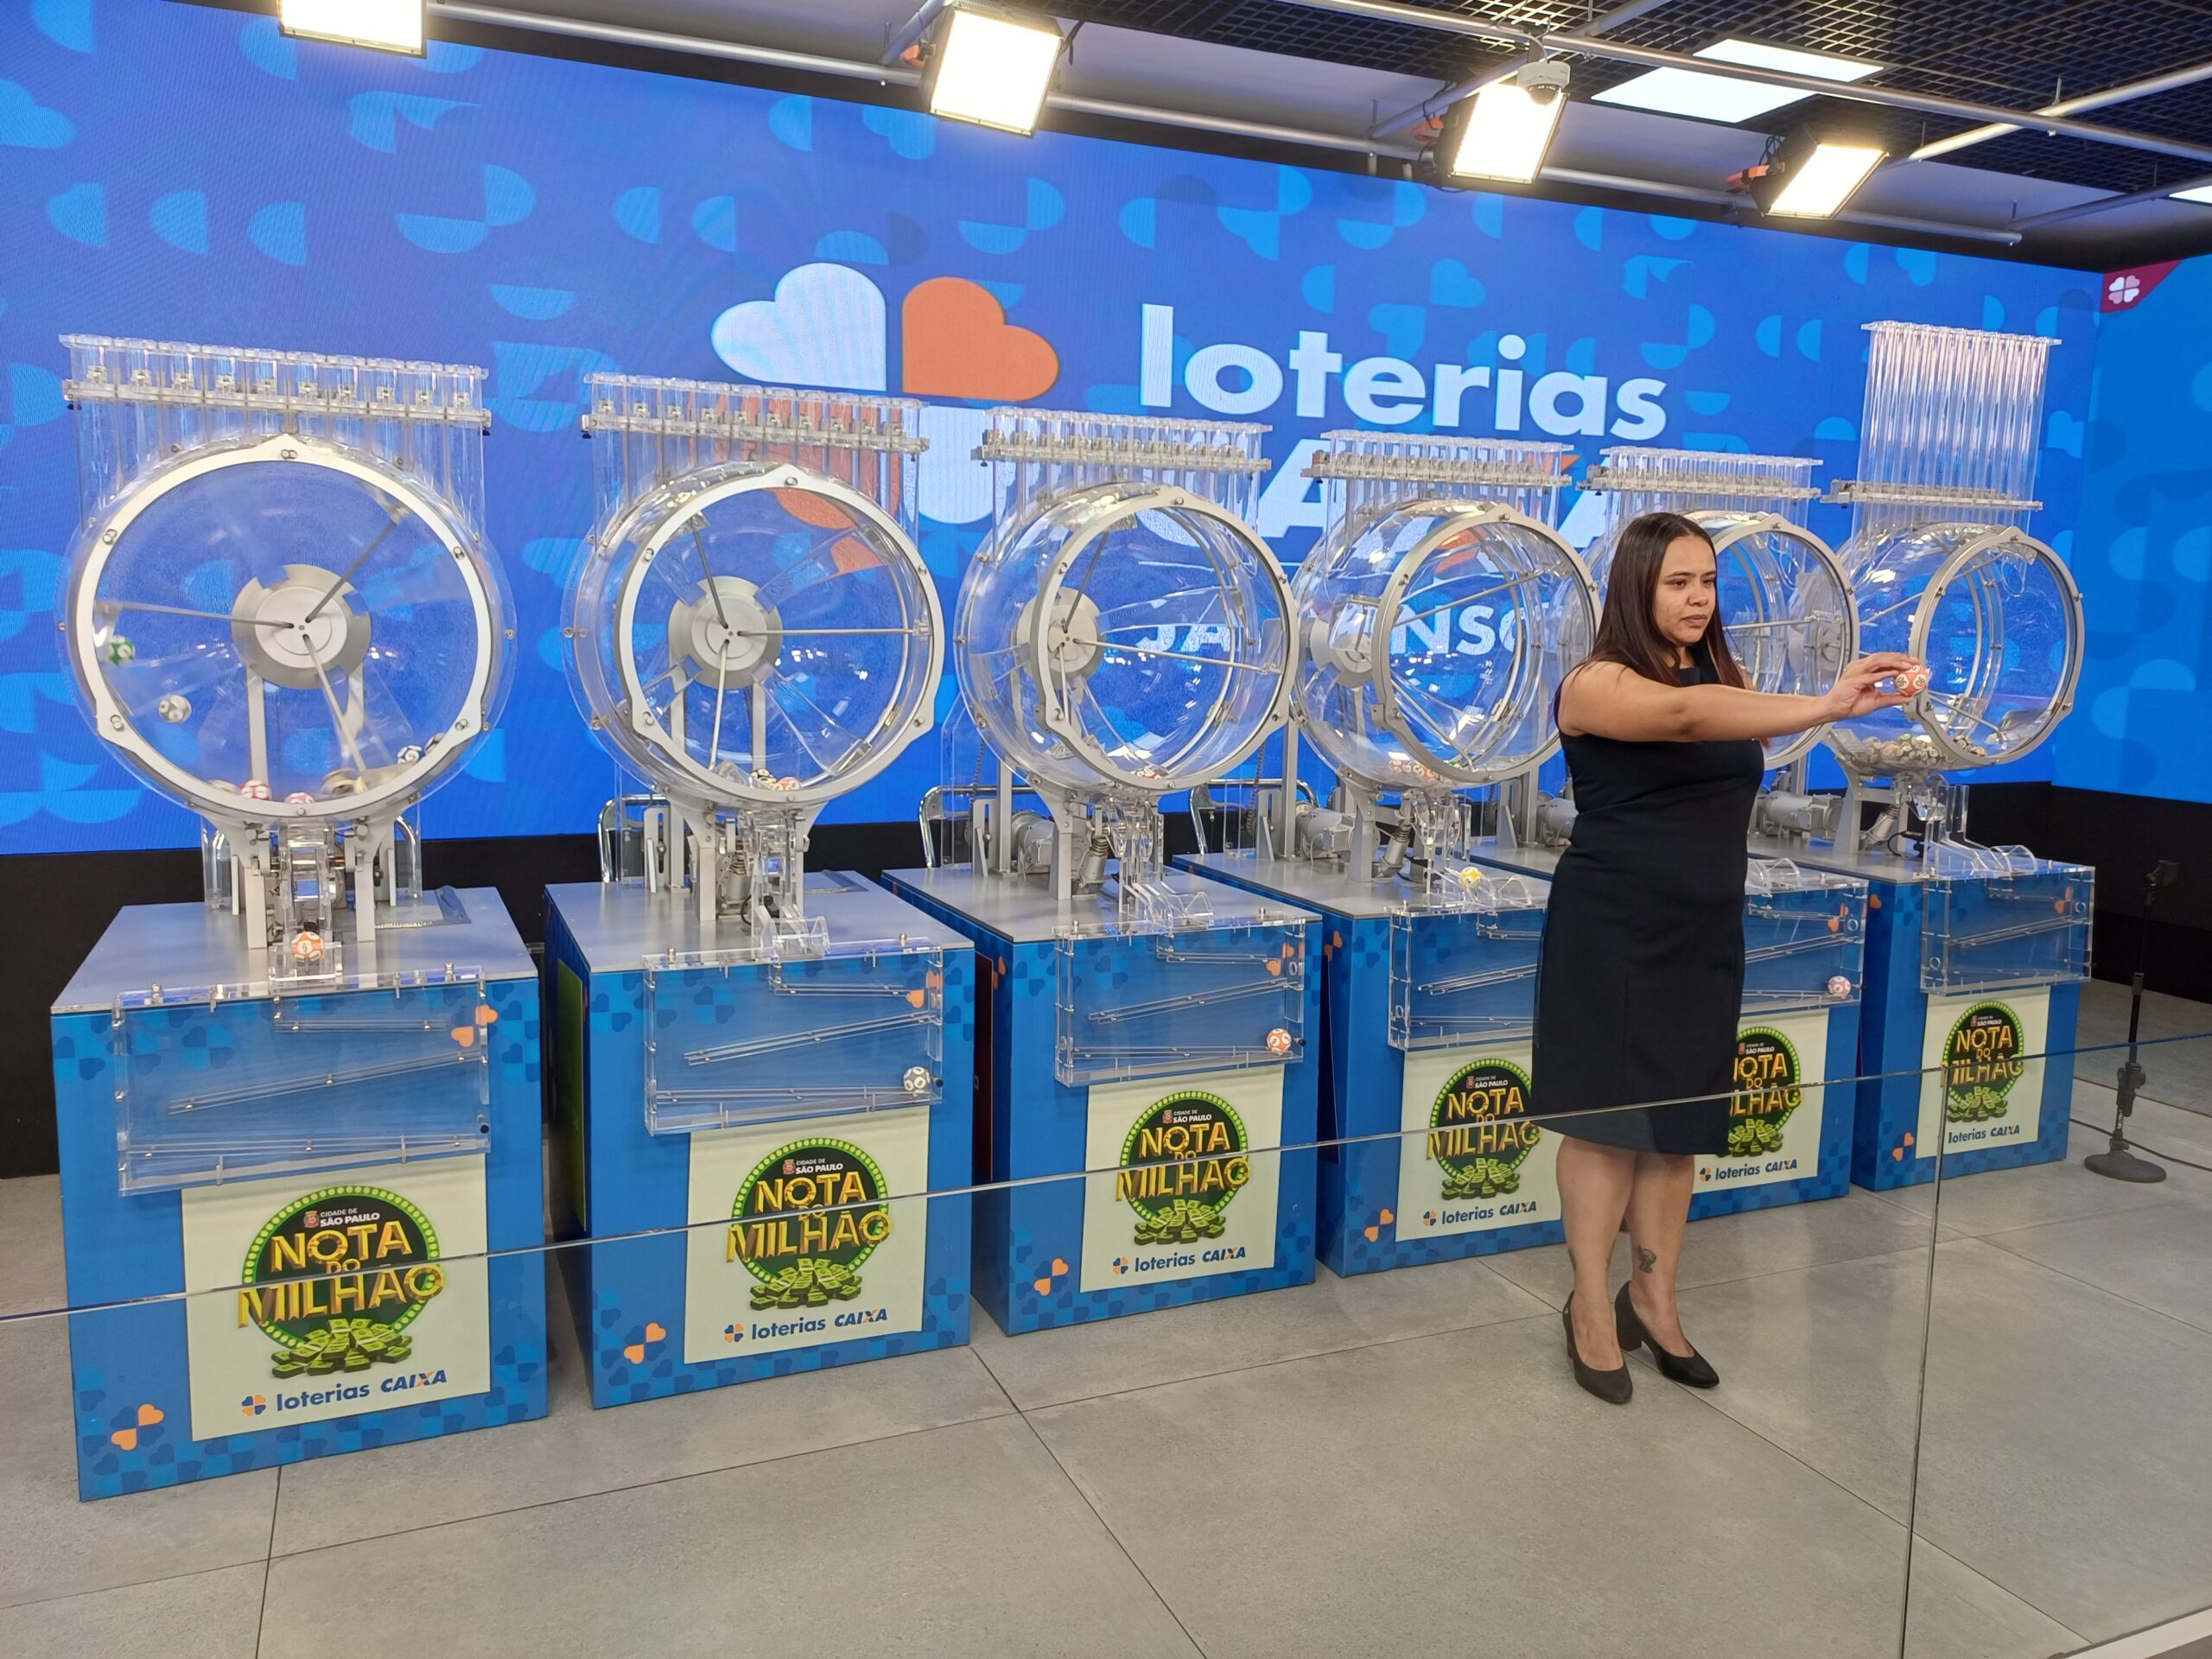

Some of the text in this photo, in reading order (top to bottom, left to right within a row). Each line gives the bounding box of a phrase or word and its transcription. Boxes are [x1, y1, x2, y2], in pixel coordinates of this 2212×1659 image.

[1140, 303, 1668, 441] loterias
[1956, 1026, 2012, 1054] NOTA
[1976, 1048, 1992, 1059] DO
[1745, 1077, 1763, 1090] DO
[1446, 1087, 1524, 1120] NOTA
[1189, 1114, 1212, 1122] PAULO
[1139, 1122, 1230, 1158] NOTA
[1948, 1125, 2020, 1144] loterias CAIXA
[795, 1163, 843, 1174] SÃO PAULO
[1715, 1160, 1797, 1180] loterias CAIXA
[754, 1171, 867, 1214] NOTA
[320, 1209, 346, 1217] CIDADE
[320, 1212, 380, 1227] SÃO PAULO
[1441, 1201, 1536, 1224] loterias CAIXA
[270, 1221, 412, 1273] NOTA
[726, 1211, 892, 1262] MILHÃO
[326, 1257, 360, 1274] DO
[1135, 1247, 1246, 1272] loterias CAIXA
[752, 1308, 887, 1339] loterias CAIXA
[276, 1370, 447, 1411] loterias CAIXA
